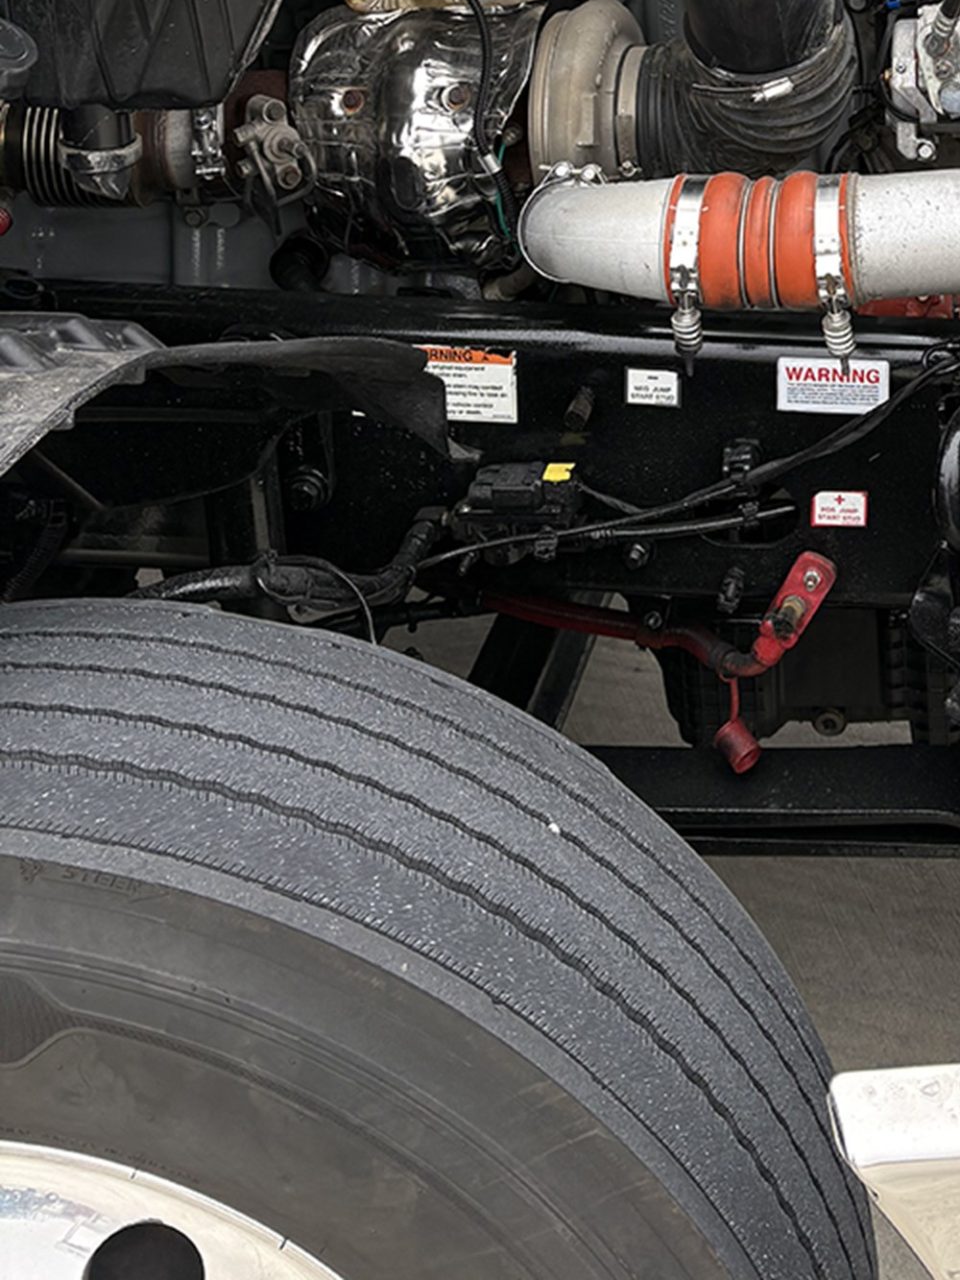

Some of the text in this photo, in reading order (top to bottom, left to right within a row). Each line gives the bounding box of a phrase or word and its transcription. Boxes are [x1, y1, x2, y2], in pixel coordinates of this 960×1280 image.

[429, 348, 473, 362] RNING
[784, 366, 881, 384] WARNING
[61, 868, 143, 894] STEER
